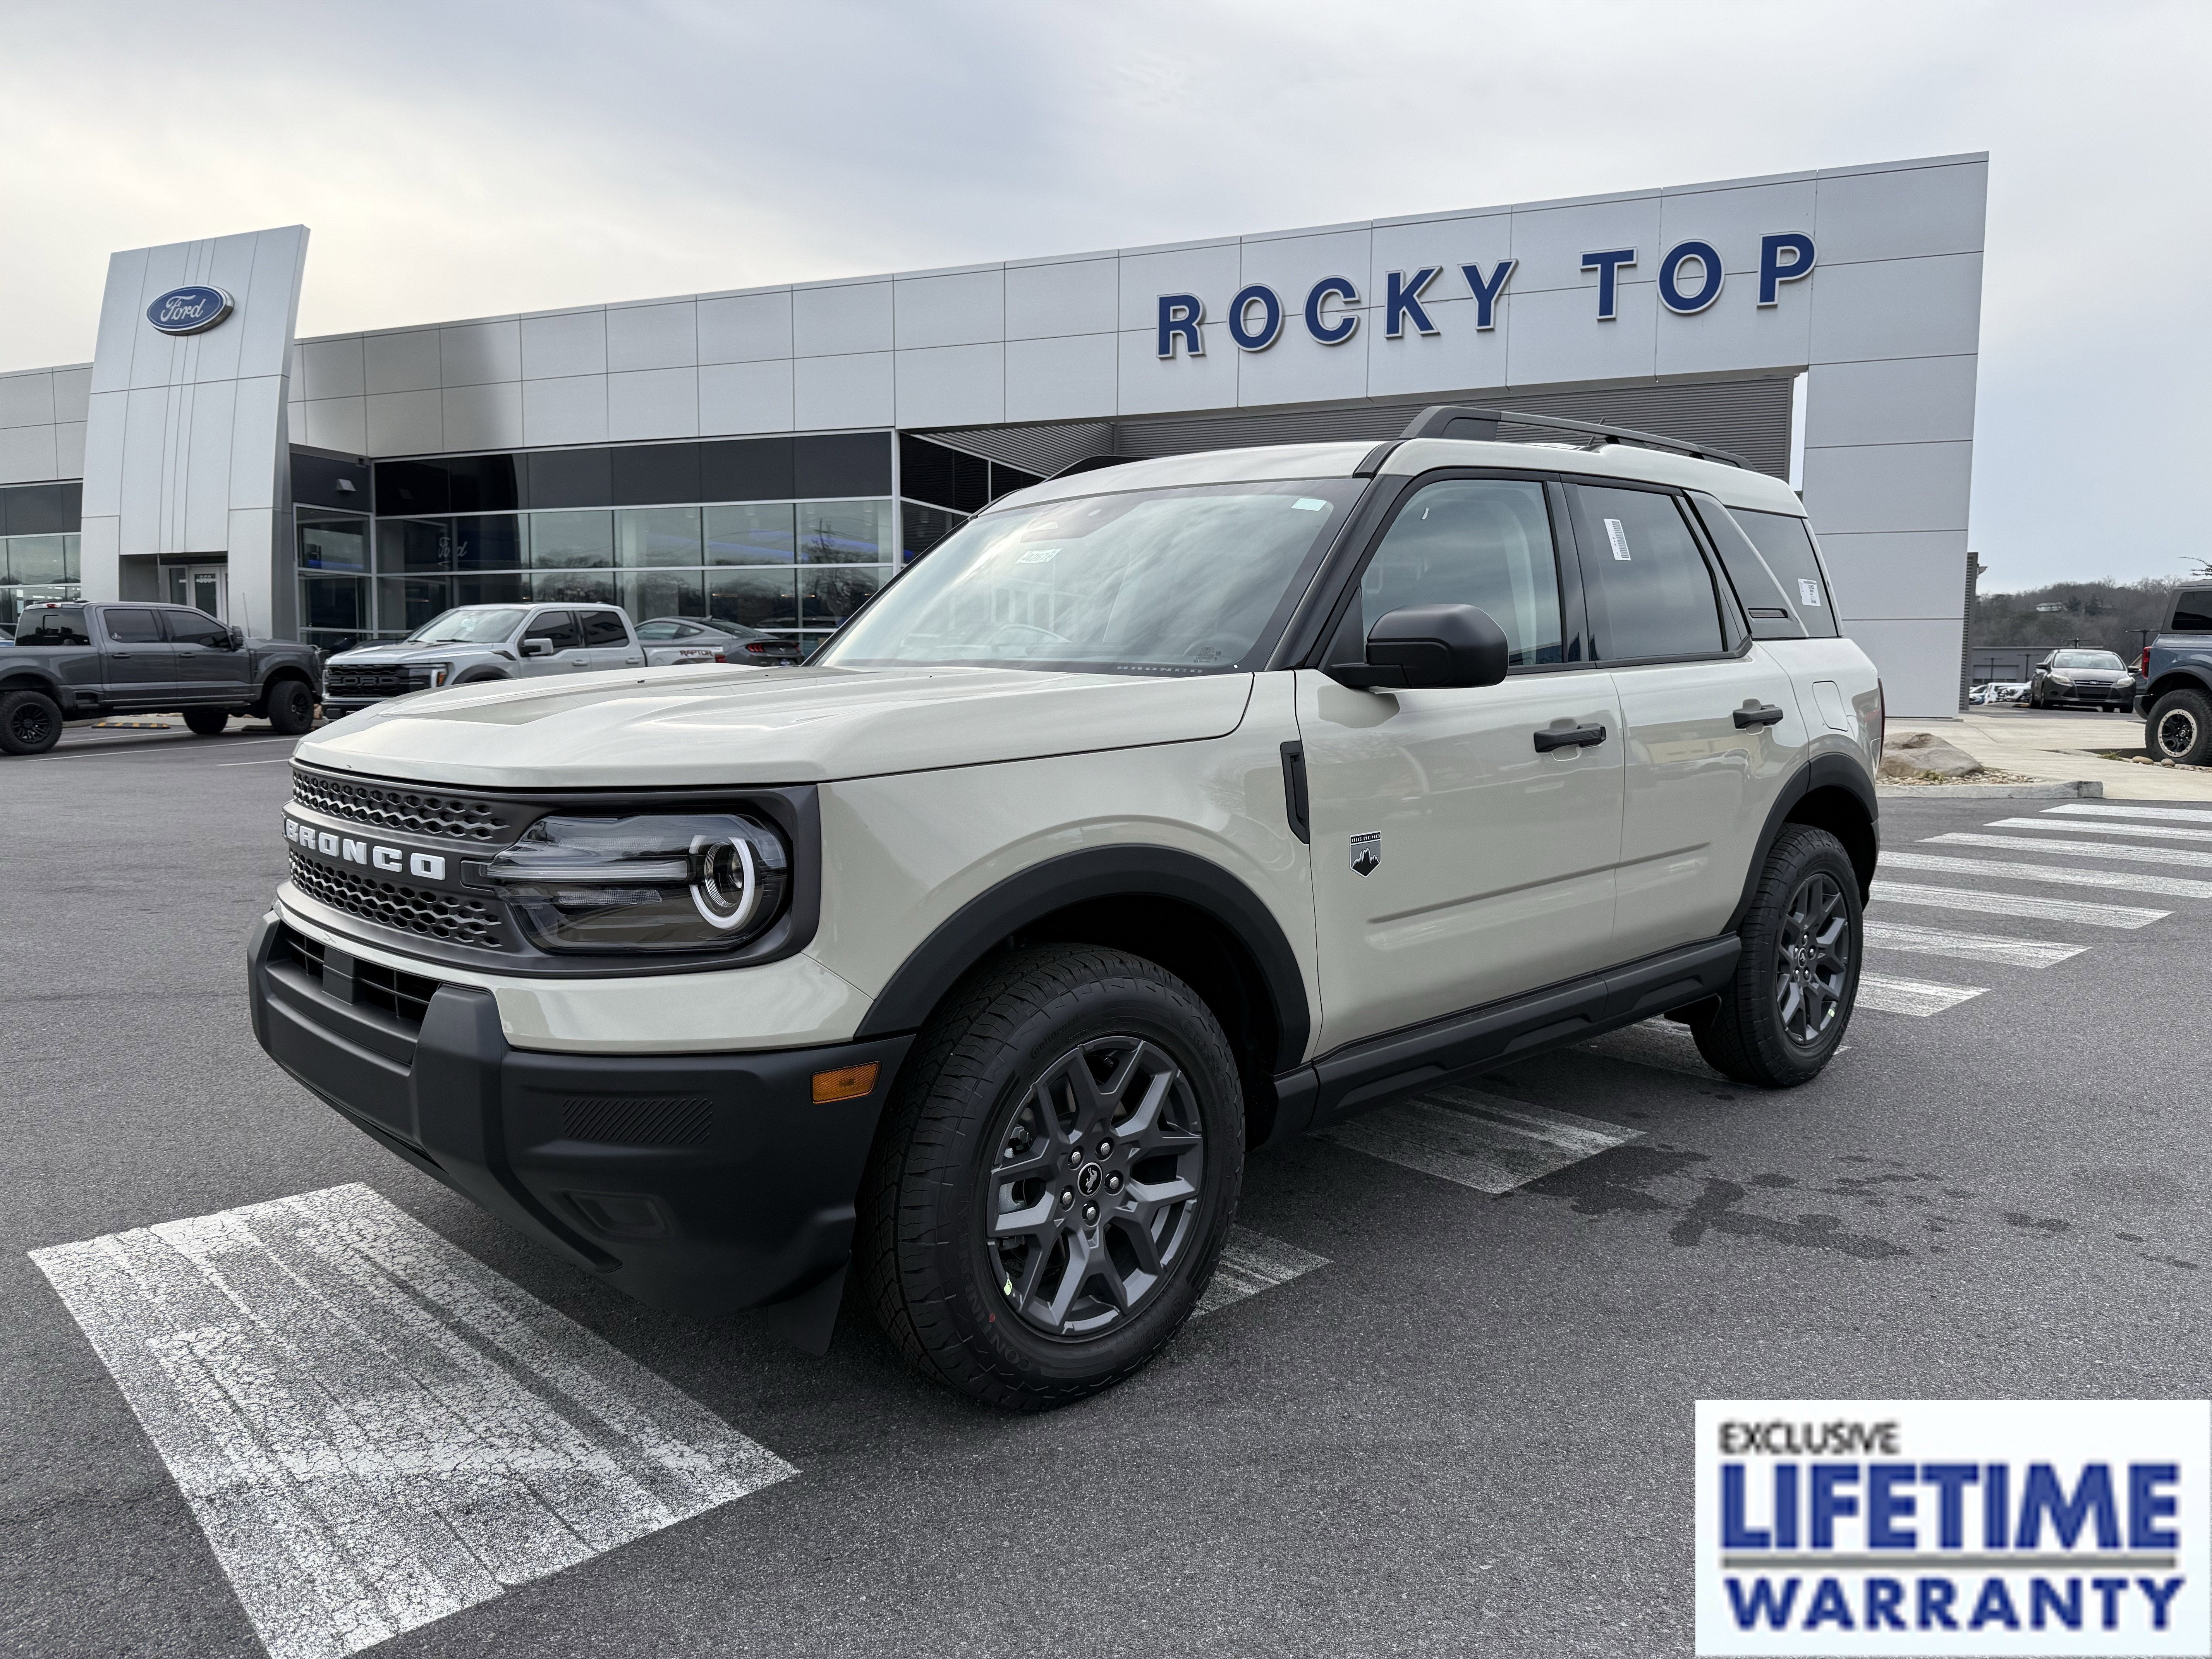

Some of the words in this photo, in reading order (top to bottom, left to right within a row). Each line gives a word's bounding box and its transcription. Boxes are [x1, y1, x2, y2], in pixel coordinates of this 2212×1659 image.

[160, 294, 206, 322] Ford
[1157, 259, 1517, 358] ROCKY
[1580, 231, 1817, 320] TOP
[286, 819, 445, 880] BRONCO
